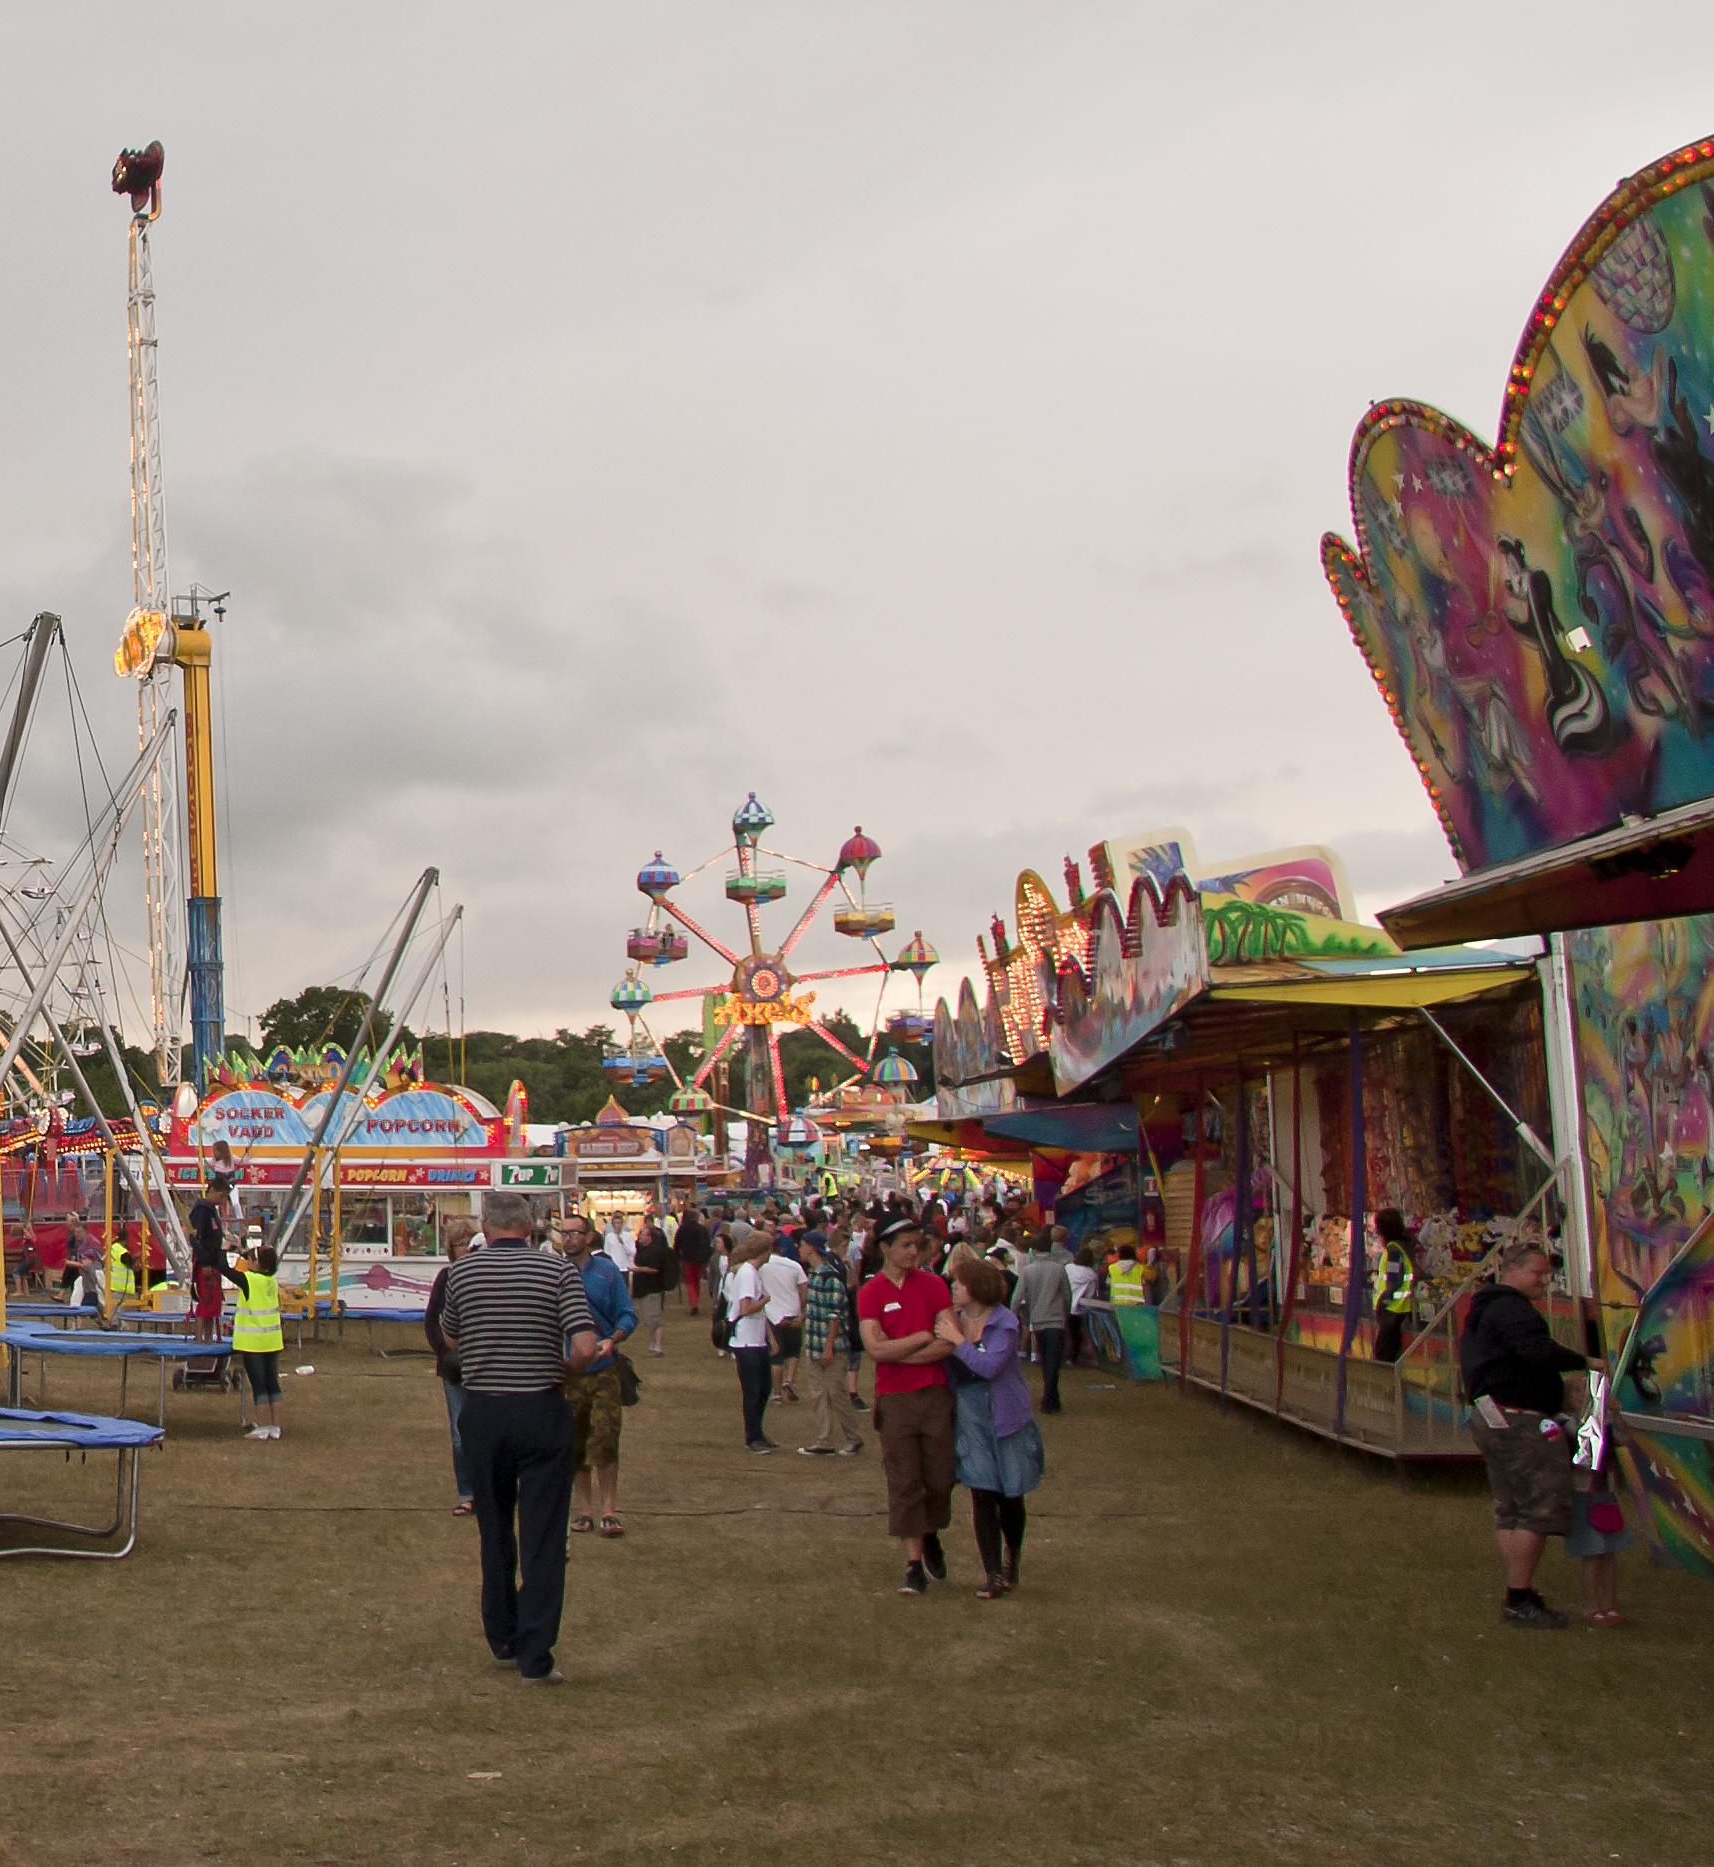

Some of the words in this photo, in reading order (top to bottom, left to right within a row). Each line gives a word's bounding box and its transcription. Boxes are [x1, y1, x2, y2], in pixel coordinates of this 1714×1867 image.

[214, 1106, 286, 1121] SOCKER
[227, 1124, 275, 1138] VADD
[366, 1118, 462, 1134] POPCORN
[348, 1168, 408, 1182] POPCORN
